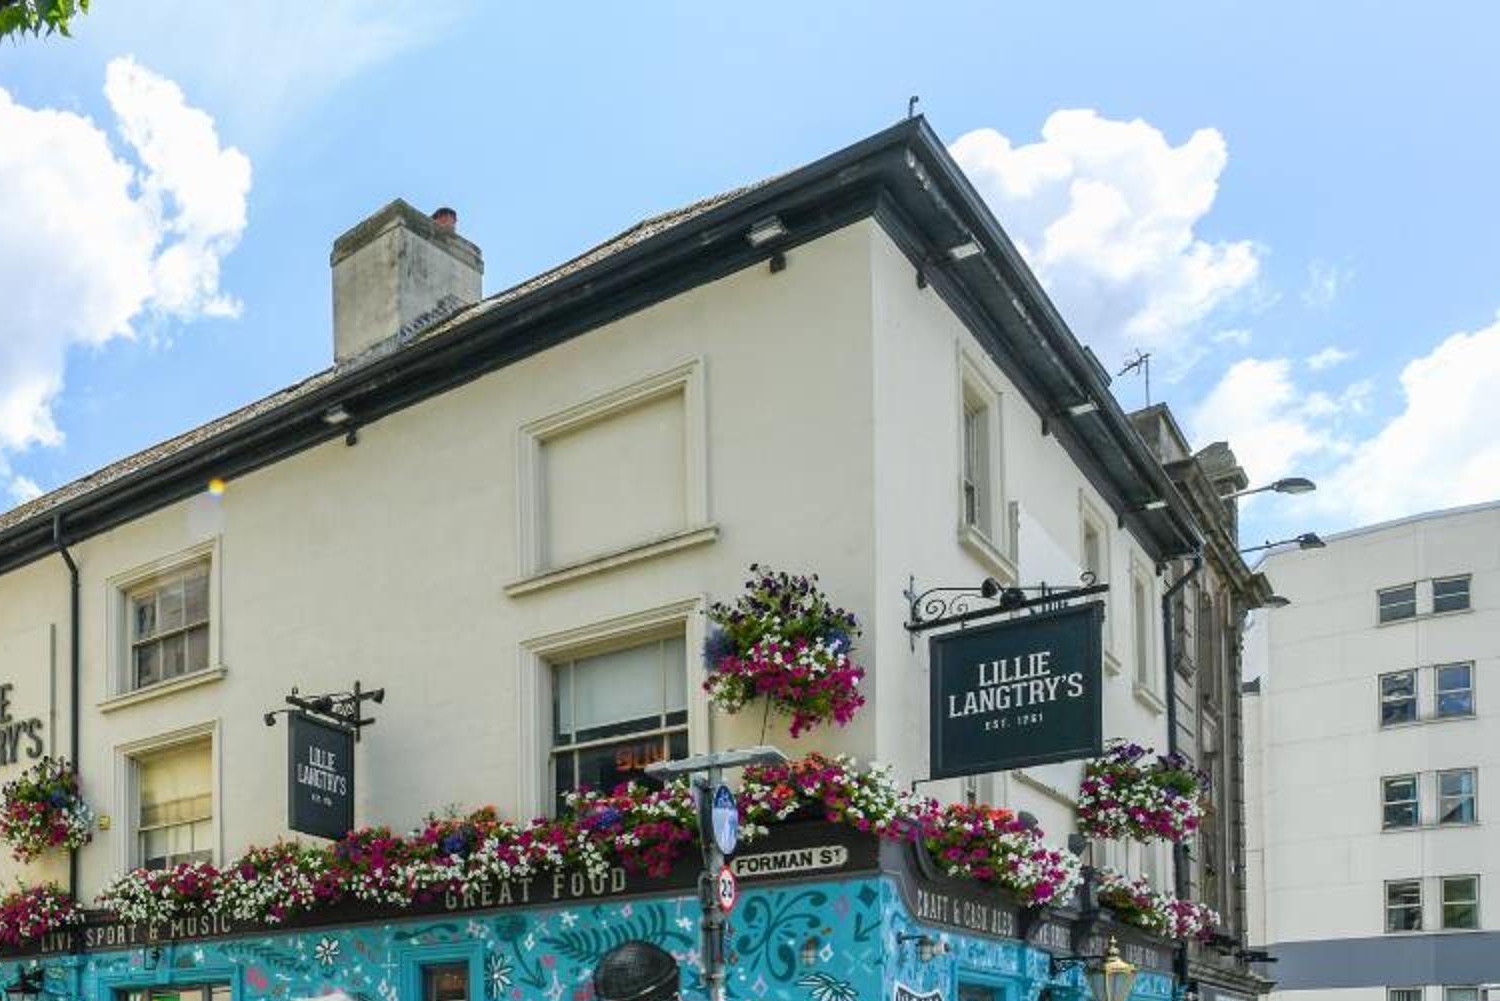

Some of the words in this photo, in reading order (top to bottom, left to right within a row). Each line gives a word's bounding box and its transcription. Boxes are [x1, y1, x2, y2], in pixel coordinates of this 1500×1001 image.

[979, 651, 1051, 687] LILLIE
[949, 672, 1084, 718] LANGTRY'S
[309, 745, 336, 770] LILLIE
[297, 763, 347, 796] LANGTRY'S
[736, 851, 813, 874] FORMAN
[445, 878, 532, 909] GREAT
[553, 867, 625, 898] FOOD
[86, 923, 136, 947] SPORT
[171, 914, 231, 938] MUSIC
